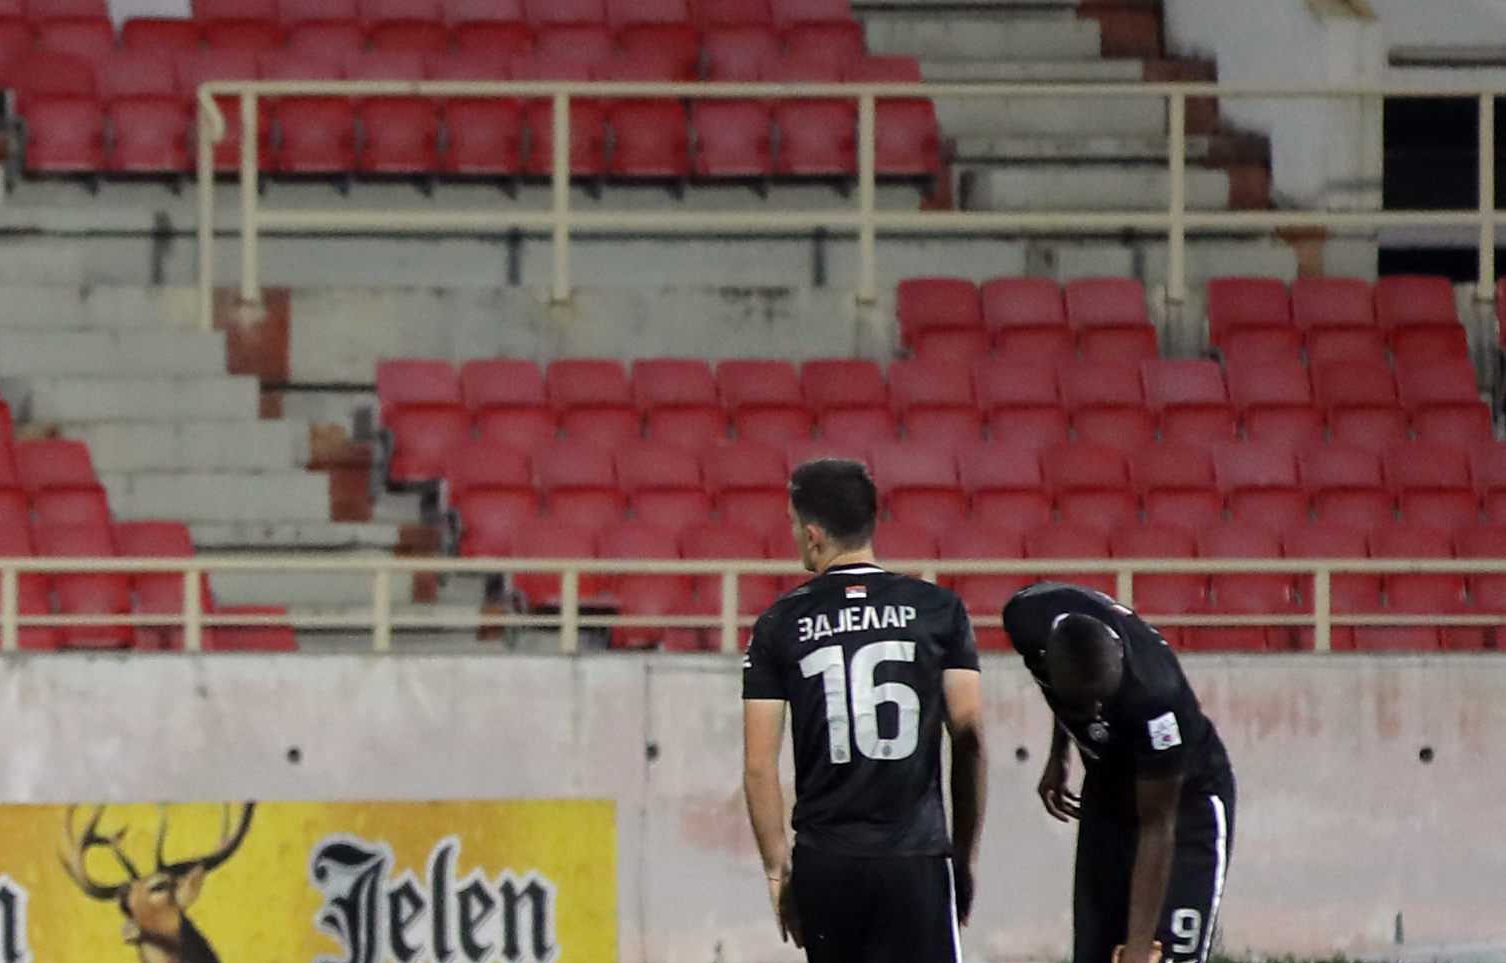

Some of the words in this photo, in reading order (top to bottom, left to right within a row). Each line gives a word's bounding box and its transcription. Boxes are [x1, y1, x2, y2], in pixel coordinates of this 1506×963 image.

[797, 605, 917, 642] ЗДЈЕЛАР
[798, 640, 921, 764] 16
[1170, 907, 1202, 954] 9
